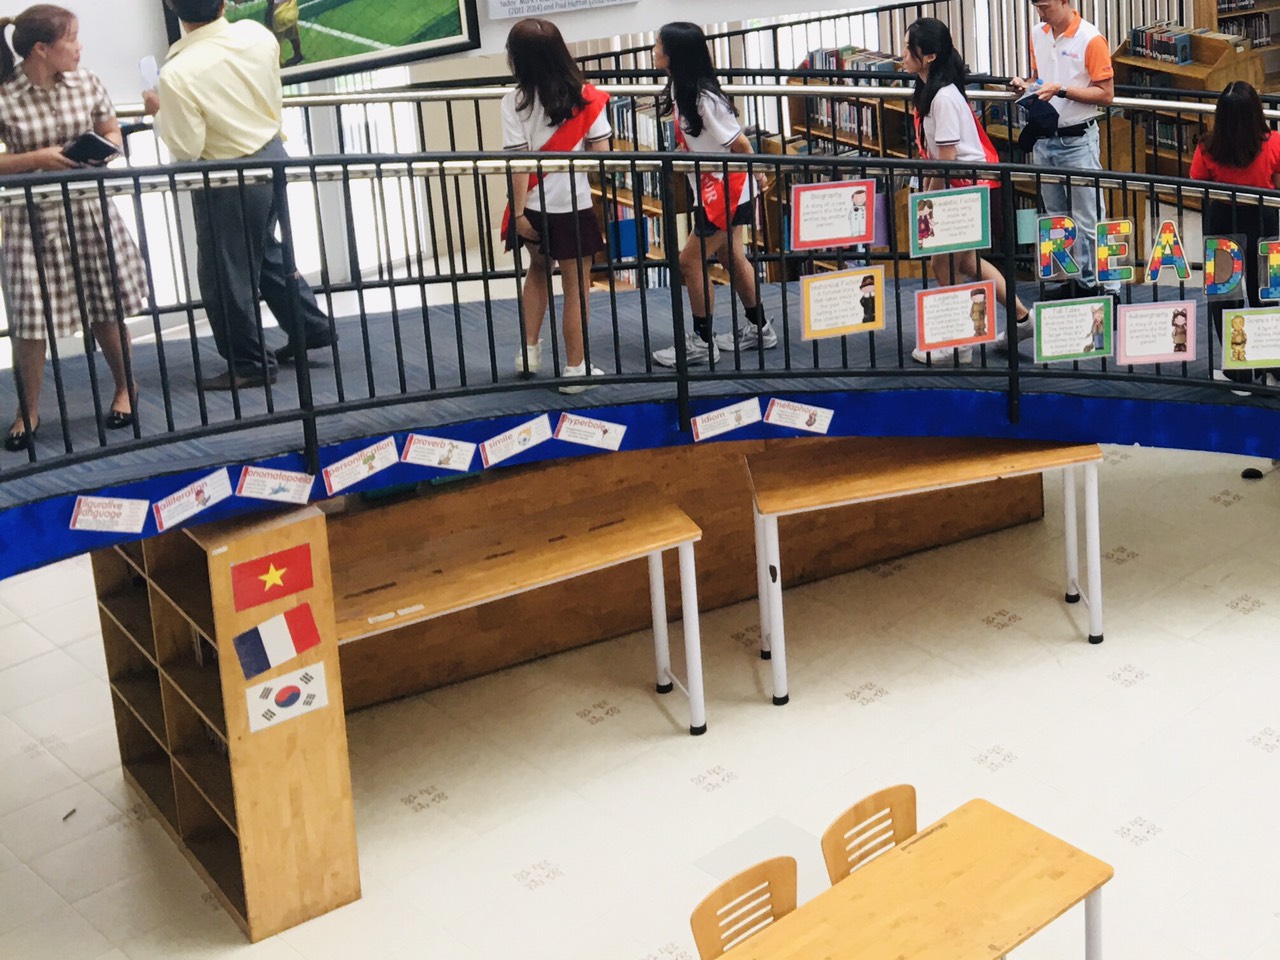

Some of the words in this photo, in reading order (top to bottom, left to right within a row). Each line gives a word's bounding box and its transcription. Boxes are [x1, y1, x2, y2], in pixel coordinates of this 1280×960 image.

[564, 414, 605, 431] hyperbole
[701, 410, 726, 425] idiom
[413, 437, 446, 449] proverb
[488, 432, 514, 449] simile
[329, 440, 394, 476] personification
[248, 469, 311, 483] onomatopoeia
[160, 481, 208, 511] alliteration
[80, 507, 122, 519] language
[81, 499, 123, 512] figurative
